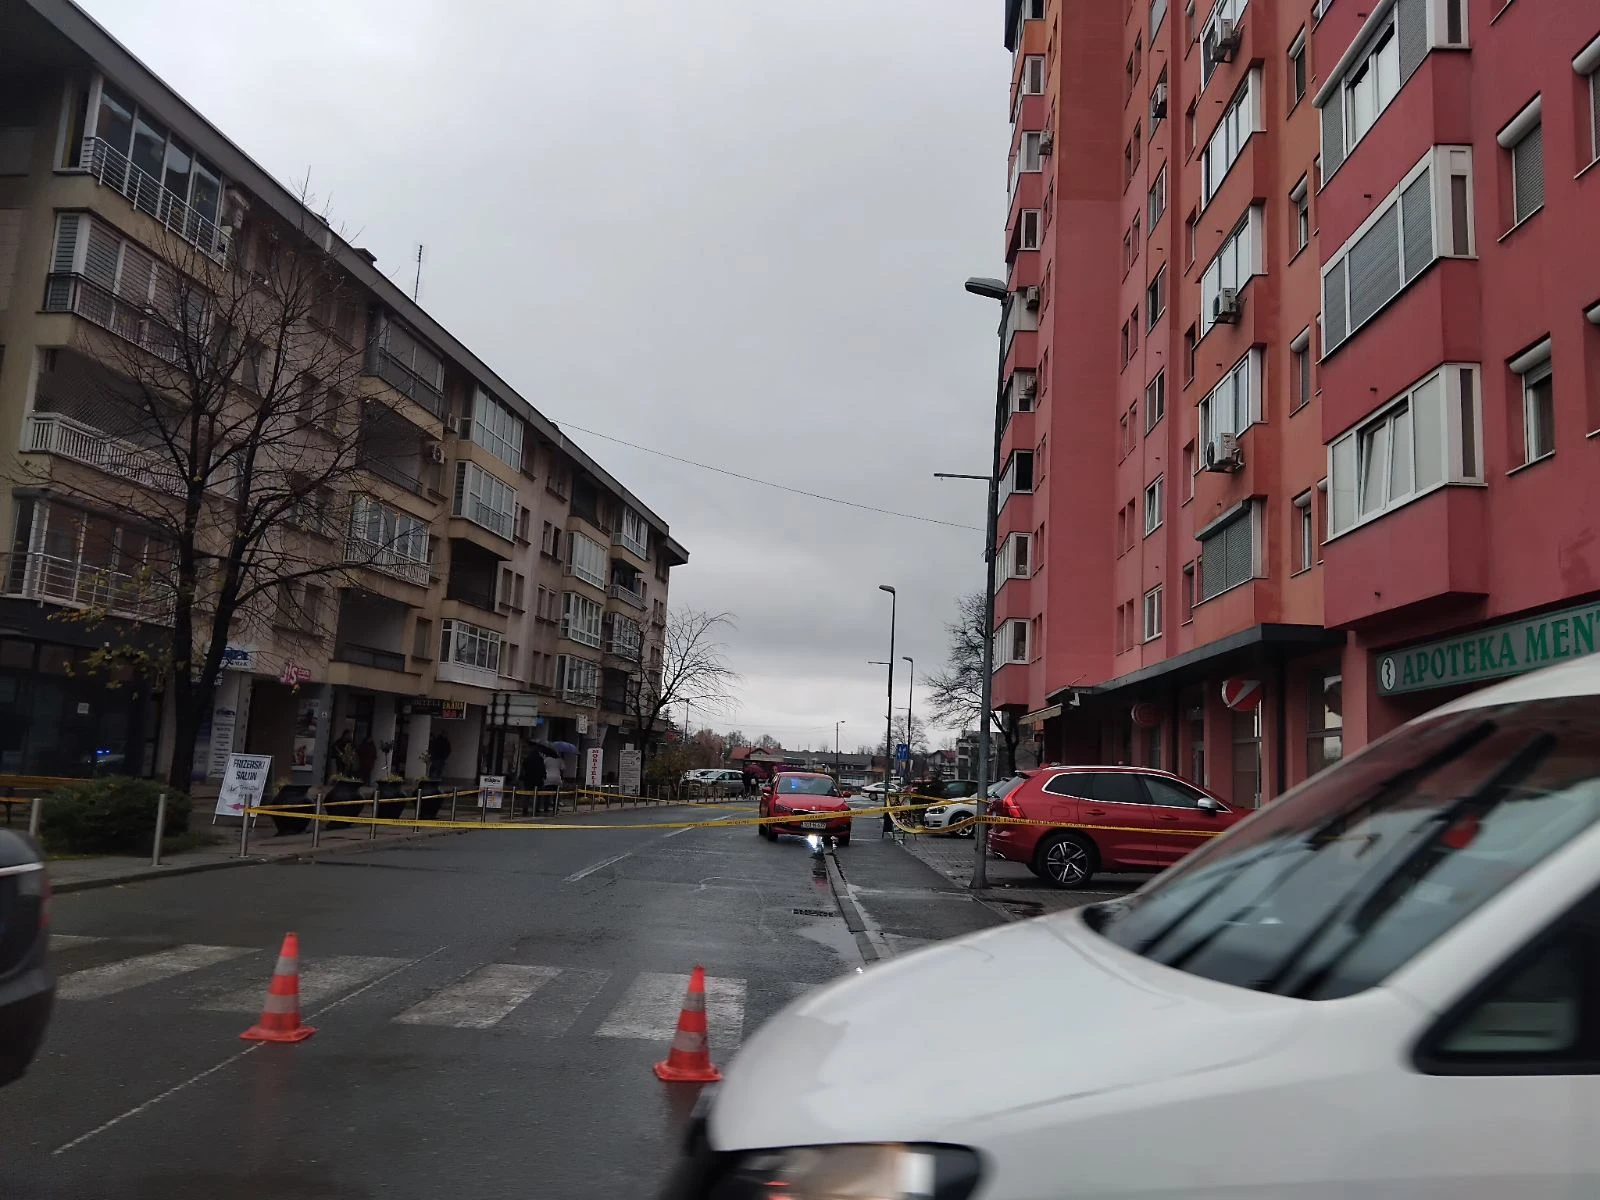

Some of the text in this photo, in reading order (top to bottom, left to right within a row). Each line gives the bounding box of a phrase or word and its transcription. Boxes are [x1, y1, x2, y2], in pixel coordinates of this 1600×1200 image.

[1402, 632, 1517, 685] APOTEKA
[232, 758, 266, 769] FRIZERSKI
[591, 749, 599, 785] MOBITELI
[236, 770, 258, 781] SALON
